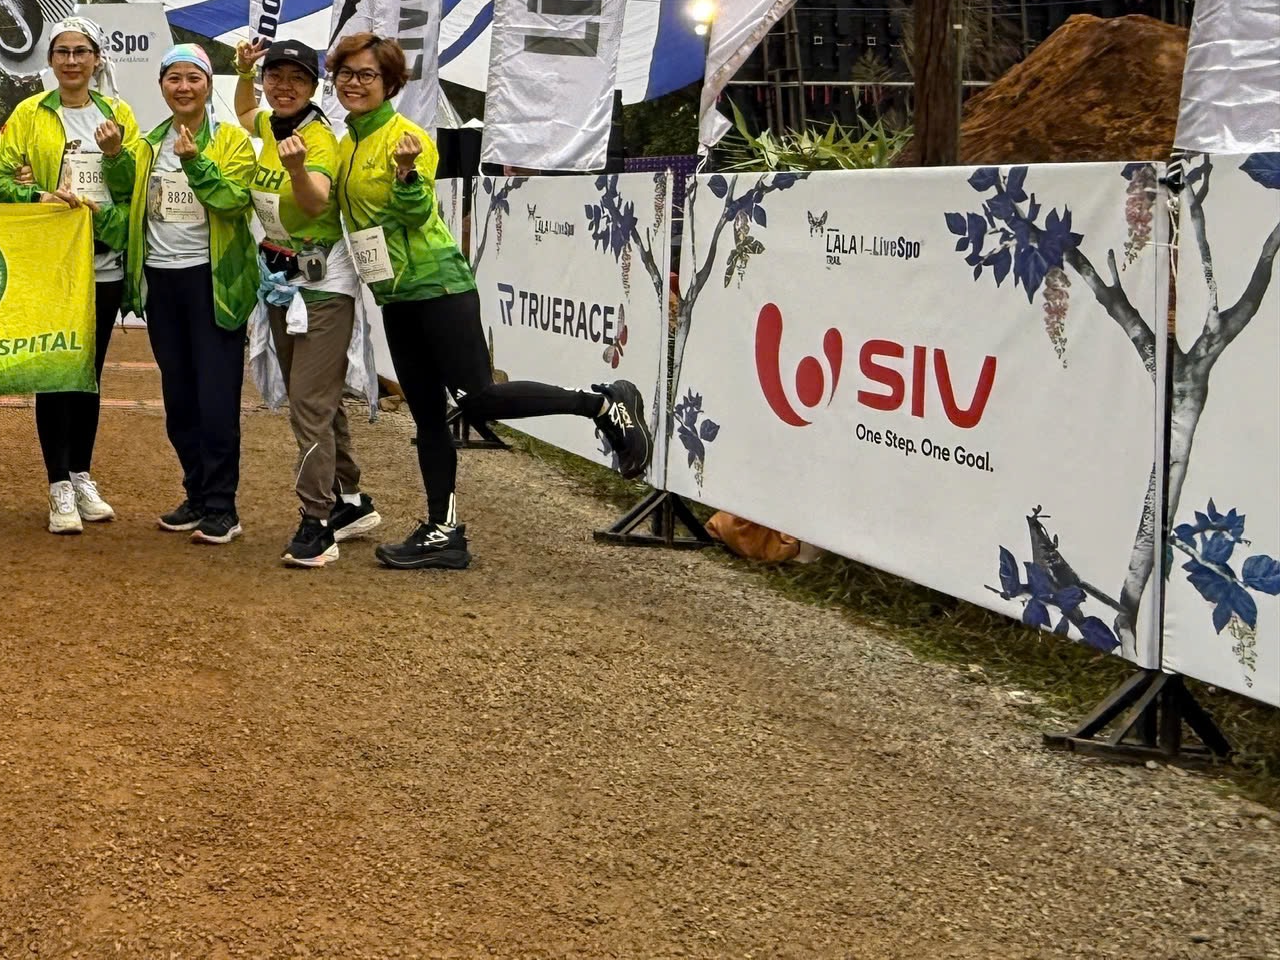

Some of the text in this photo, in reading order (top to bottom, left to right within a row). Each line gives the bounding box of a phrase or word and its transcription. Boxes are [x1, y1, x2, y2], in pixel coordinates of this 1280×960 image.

[167, 191, 194, 204] 8828
[519, 290, 615, 346] TRUERACE
[857, 339, 997, 429] SIV
[856, 423, 994, 473] One Step. One Goal.
